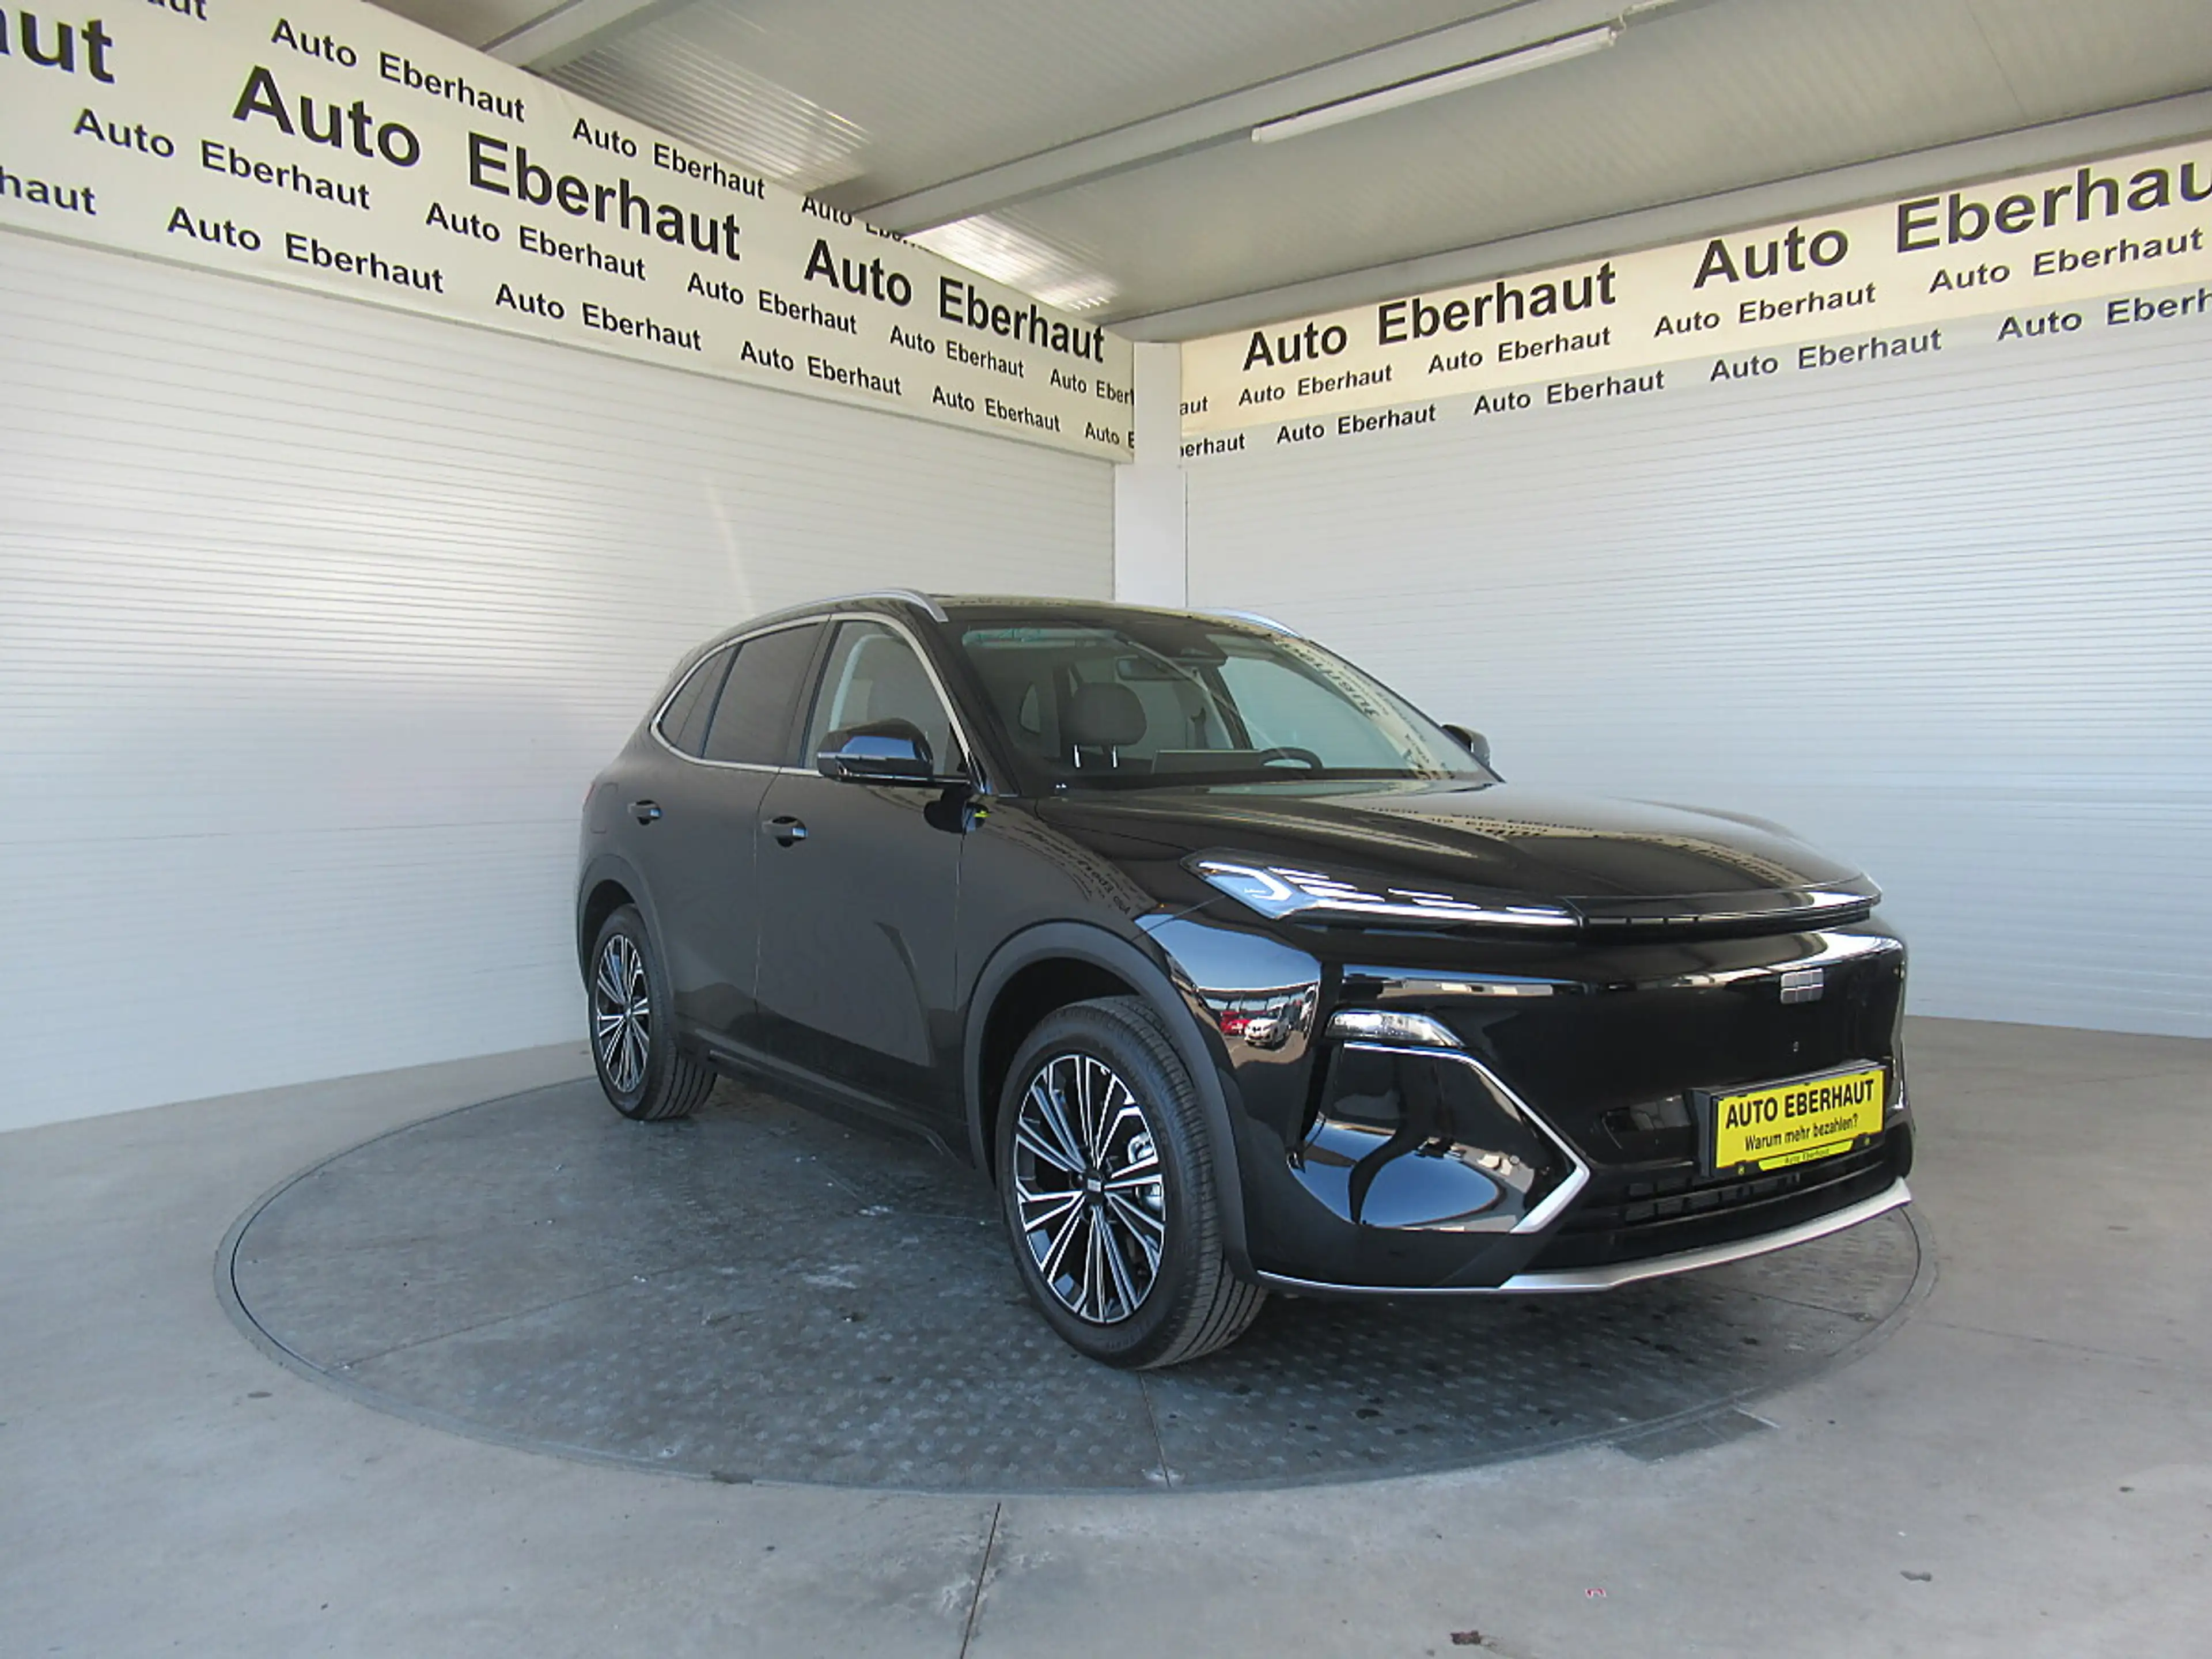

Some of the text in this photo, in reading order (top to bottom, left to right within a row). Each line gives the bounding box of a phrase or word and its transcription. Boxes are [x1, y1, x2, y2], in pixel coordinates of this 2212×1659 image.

[147, 0, 207, 21] ut
[0, 8, 115, 84] ut
[271, 18, 524, 123] Auto Eberhaut
[73, 108, 370, 210] Auto Eberhaut
[233, 65, 741, 261] Auto Eberhaut
[573, 118, 765, 200] Auto Eberhaut
[167, 207, 444, 294] Auto Eberhaut
[426, 202, 646, 281] Auto Eberhaut
[1694, 226, 1848, 289] Auto
[1930, 228, 2203, 293] Auto Eberhaut
[495, 283, 702, 351] Auto Eberhaut
[687, 272, 857, 335] Auto Eberhaut
[804, 238, 1104, 363] Auto Eberhaut
[1243, 262, 1616, 371] Auto Eberhaut
[1654, 283, 1876, 337] Auto Eberhaut
[1998, 311, 2082, 340] Auto
[741, 340, 902, 396] Auto Eberhaut
[890, 325, 1024, 378] Auto Eberhaut
[1428, 327, 1609, 374] Auto Eberhaut
[1710, 329, 1941, 382] Auto Eberhaut
[1050, 368, 1087, 393] Auto
[1238, 365, 1391, 406] Auto Eberhaut
[1474, 370, 1664, 415] Auto Eberhaut
[932, 385, 1060, 432] Auto Eberhaut
[1085, 422, 1120, 445] Auto
[1277, 404, 1435, 444] Auto Eberhaut
[1725, 1079, 1874, 1129] AUTO EBERHAUT
[1745, 1112, 1858, 1152] Warum mehr bezahlen?
